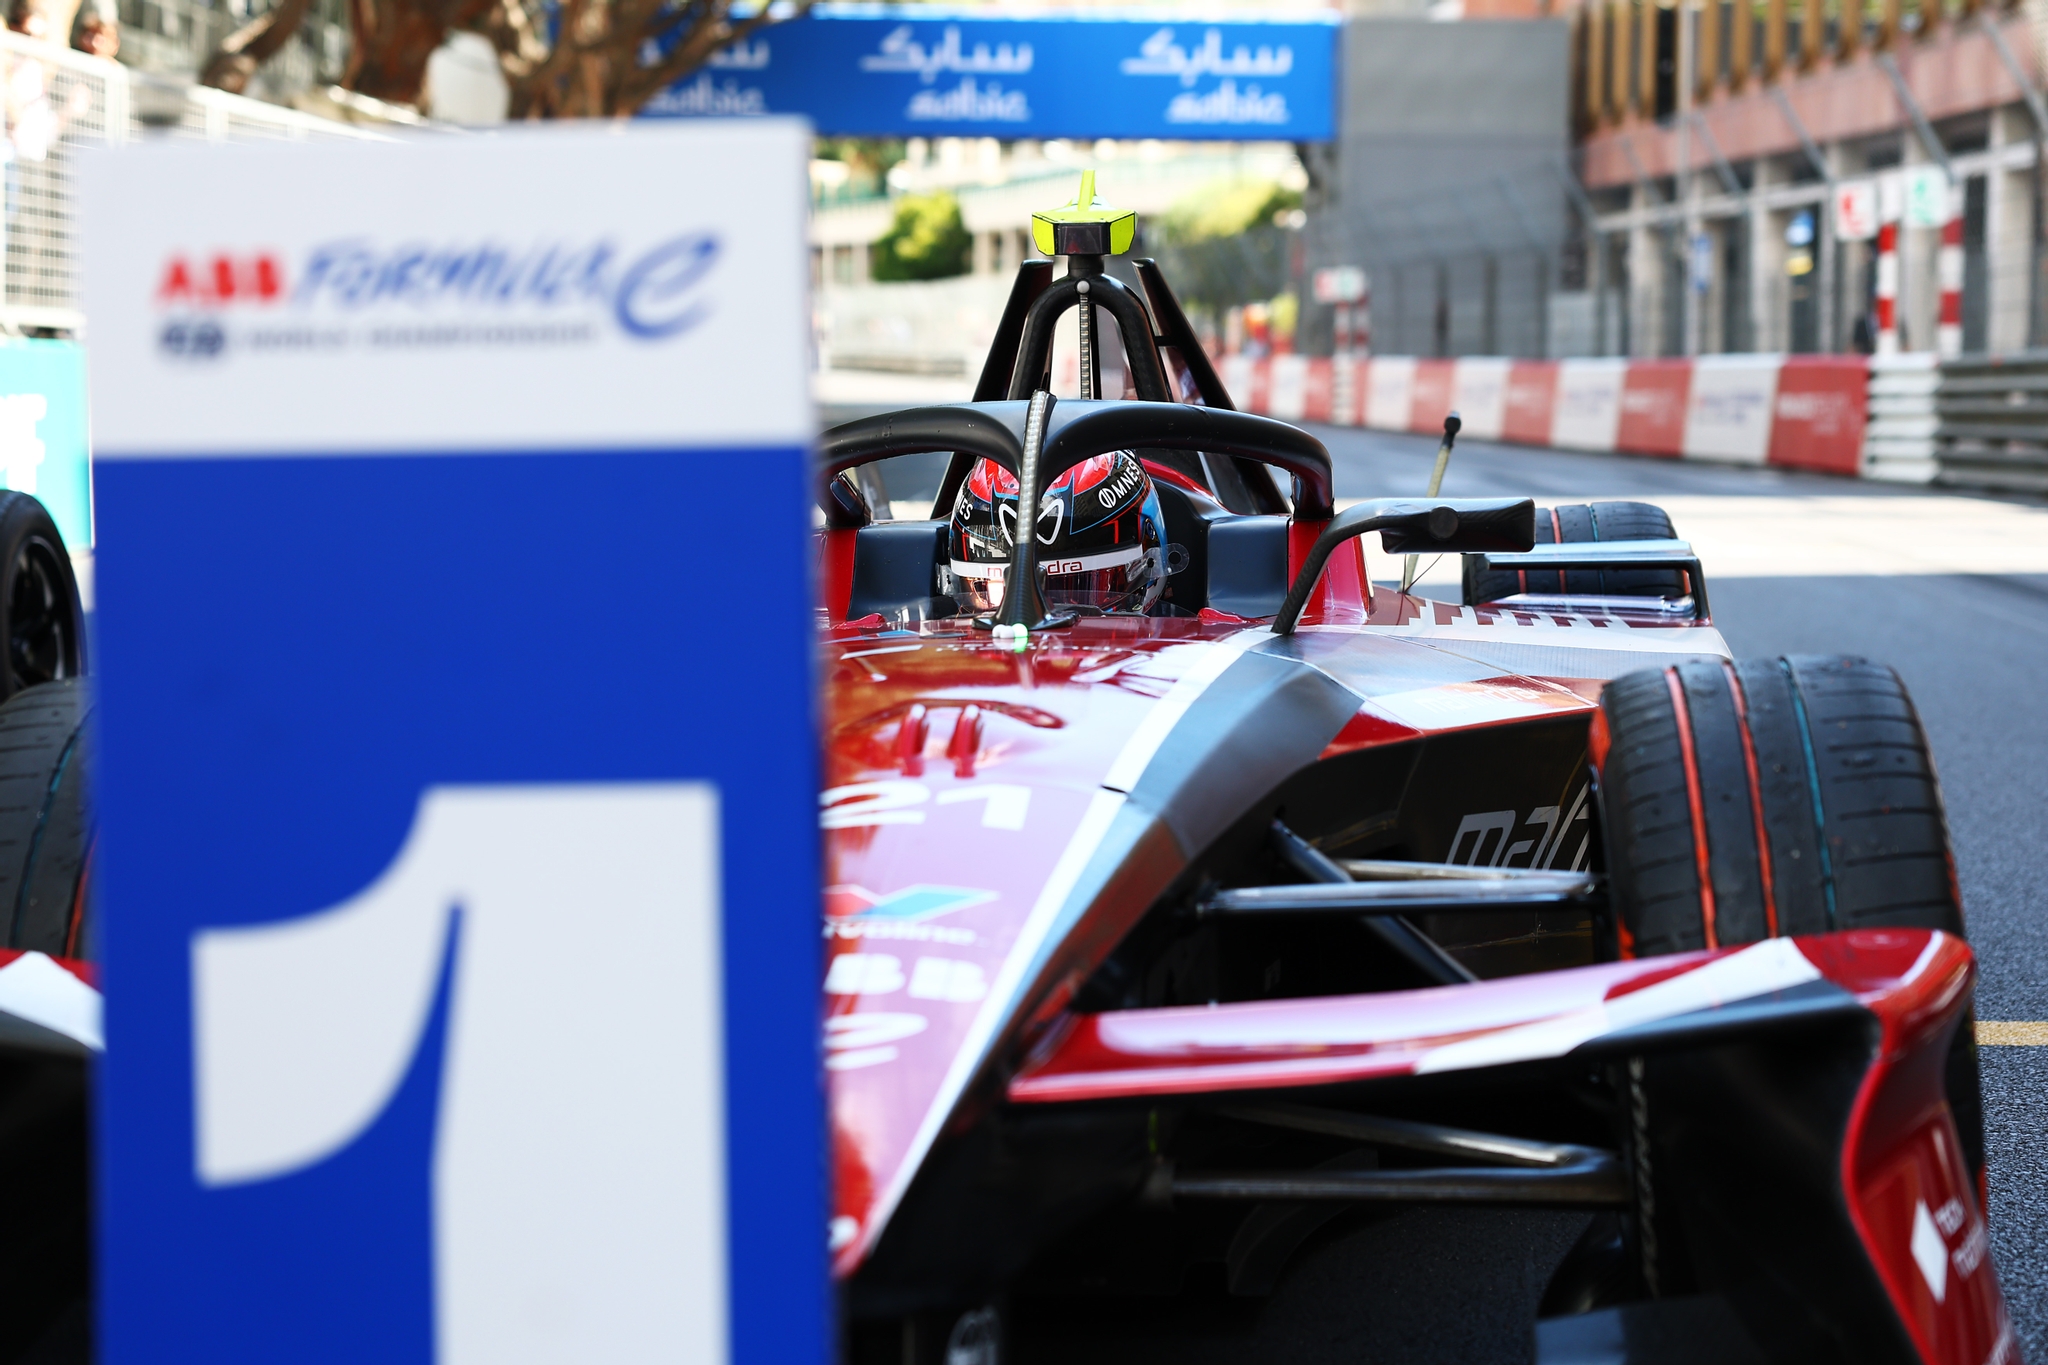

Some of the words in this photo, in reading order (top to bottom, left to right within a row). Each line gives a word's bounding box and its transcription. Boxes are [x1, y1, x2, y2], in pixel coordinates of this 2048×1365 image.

[154, 251, 282, 300] ABB
[1098, 461, 1140, 508] OMNES
[190, 780, 732, 1365] 1
